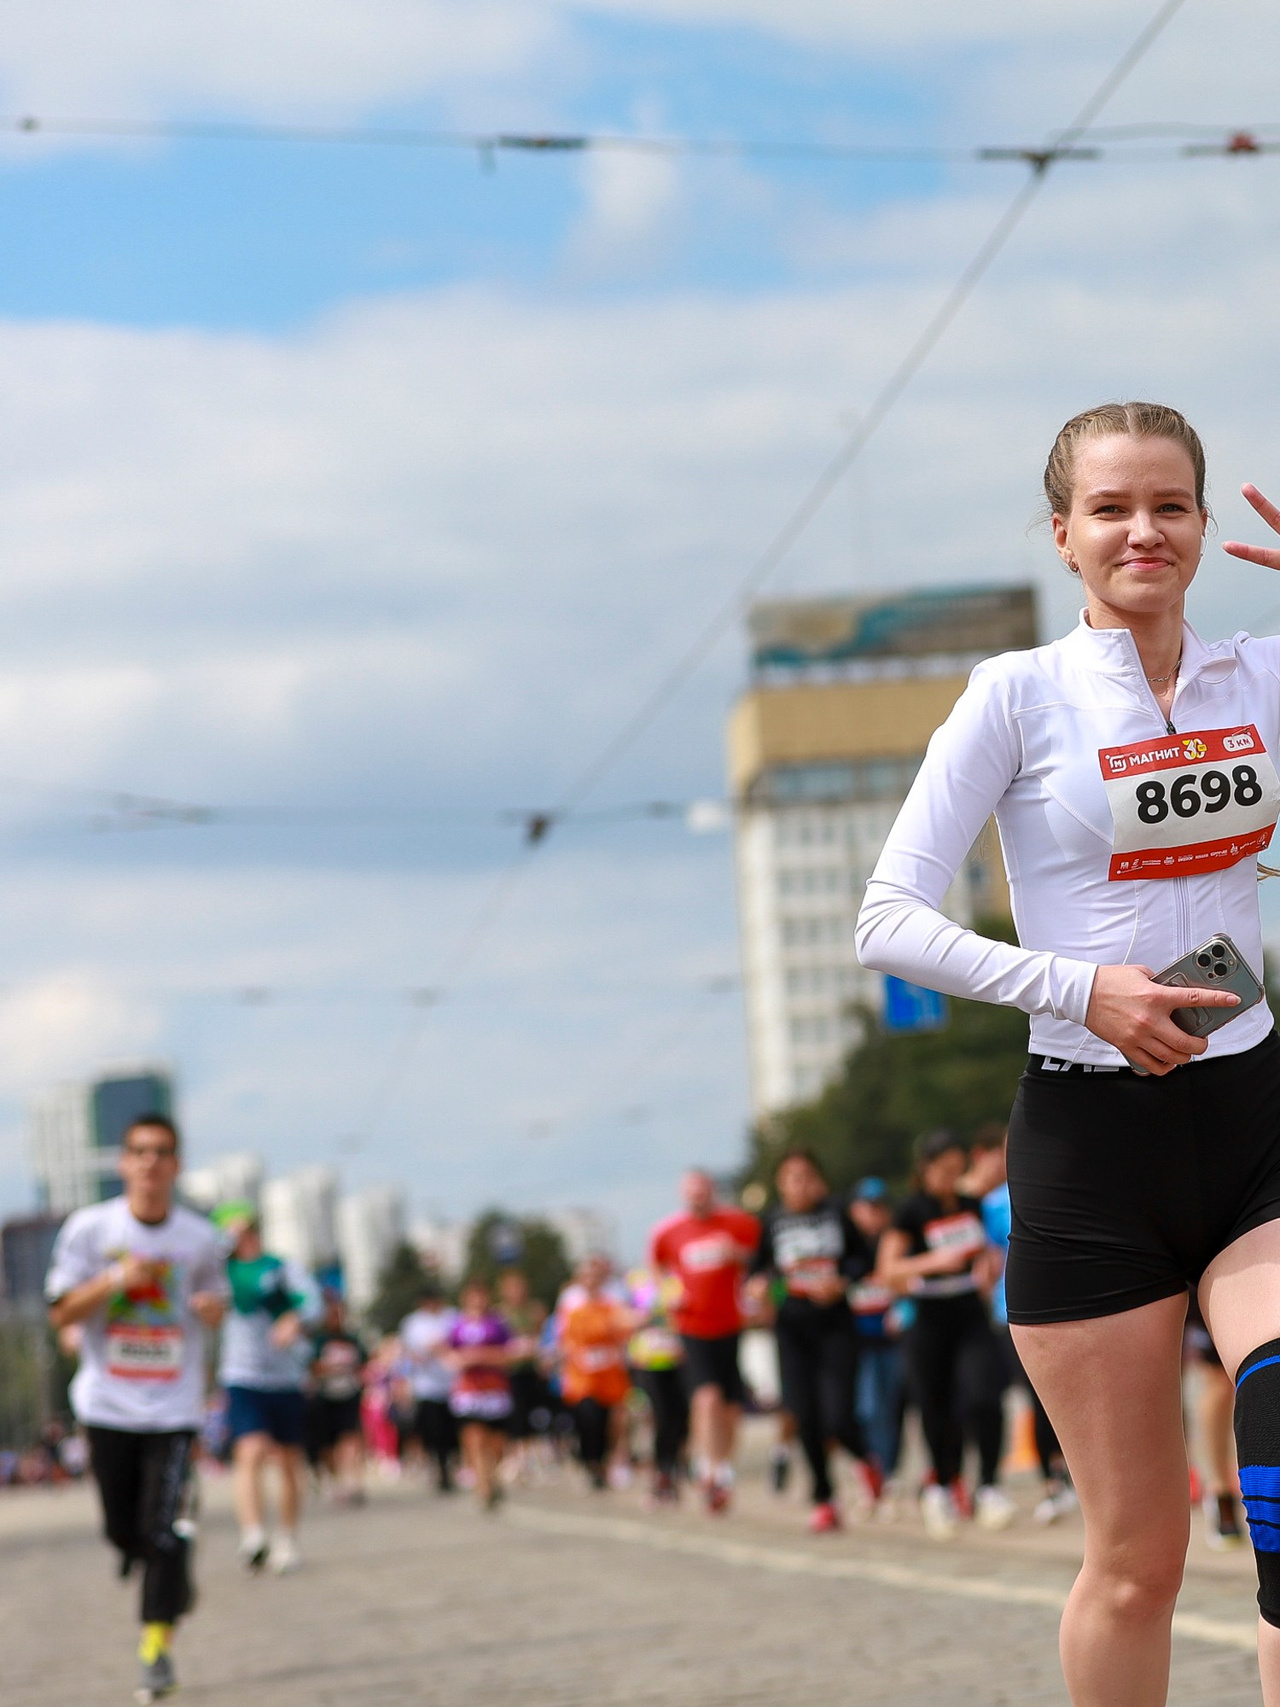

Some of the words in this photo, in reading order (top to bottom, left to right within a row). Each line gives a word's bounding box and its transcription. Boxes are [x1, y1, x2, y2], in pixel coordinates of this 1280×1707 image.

[1227, 740, 1235, 749] 3
[1129, 747, 1180, 766] МАГНИТ
[1136, 764, 1262, 824] 8698
